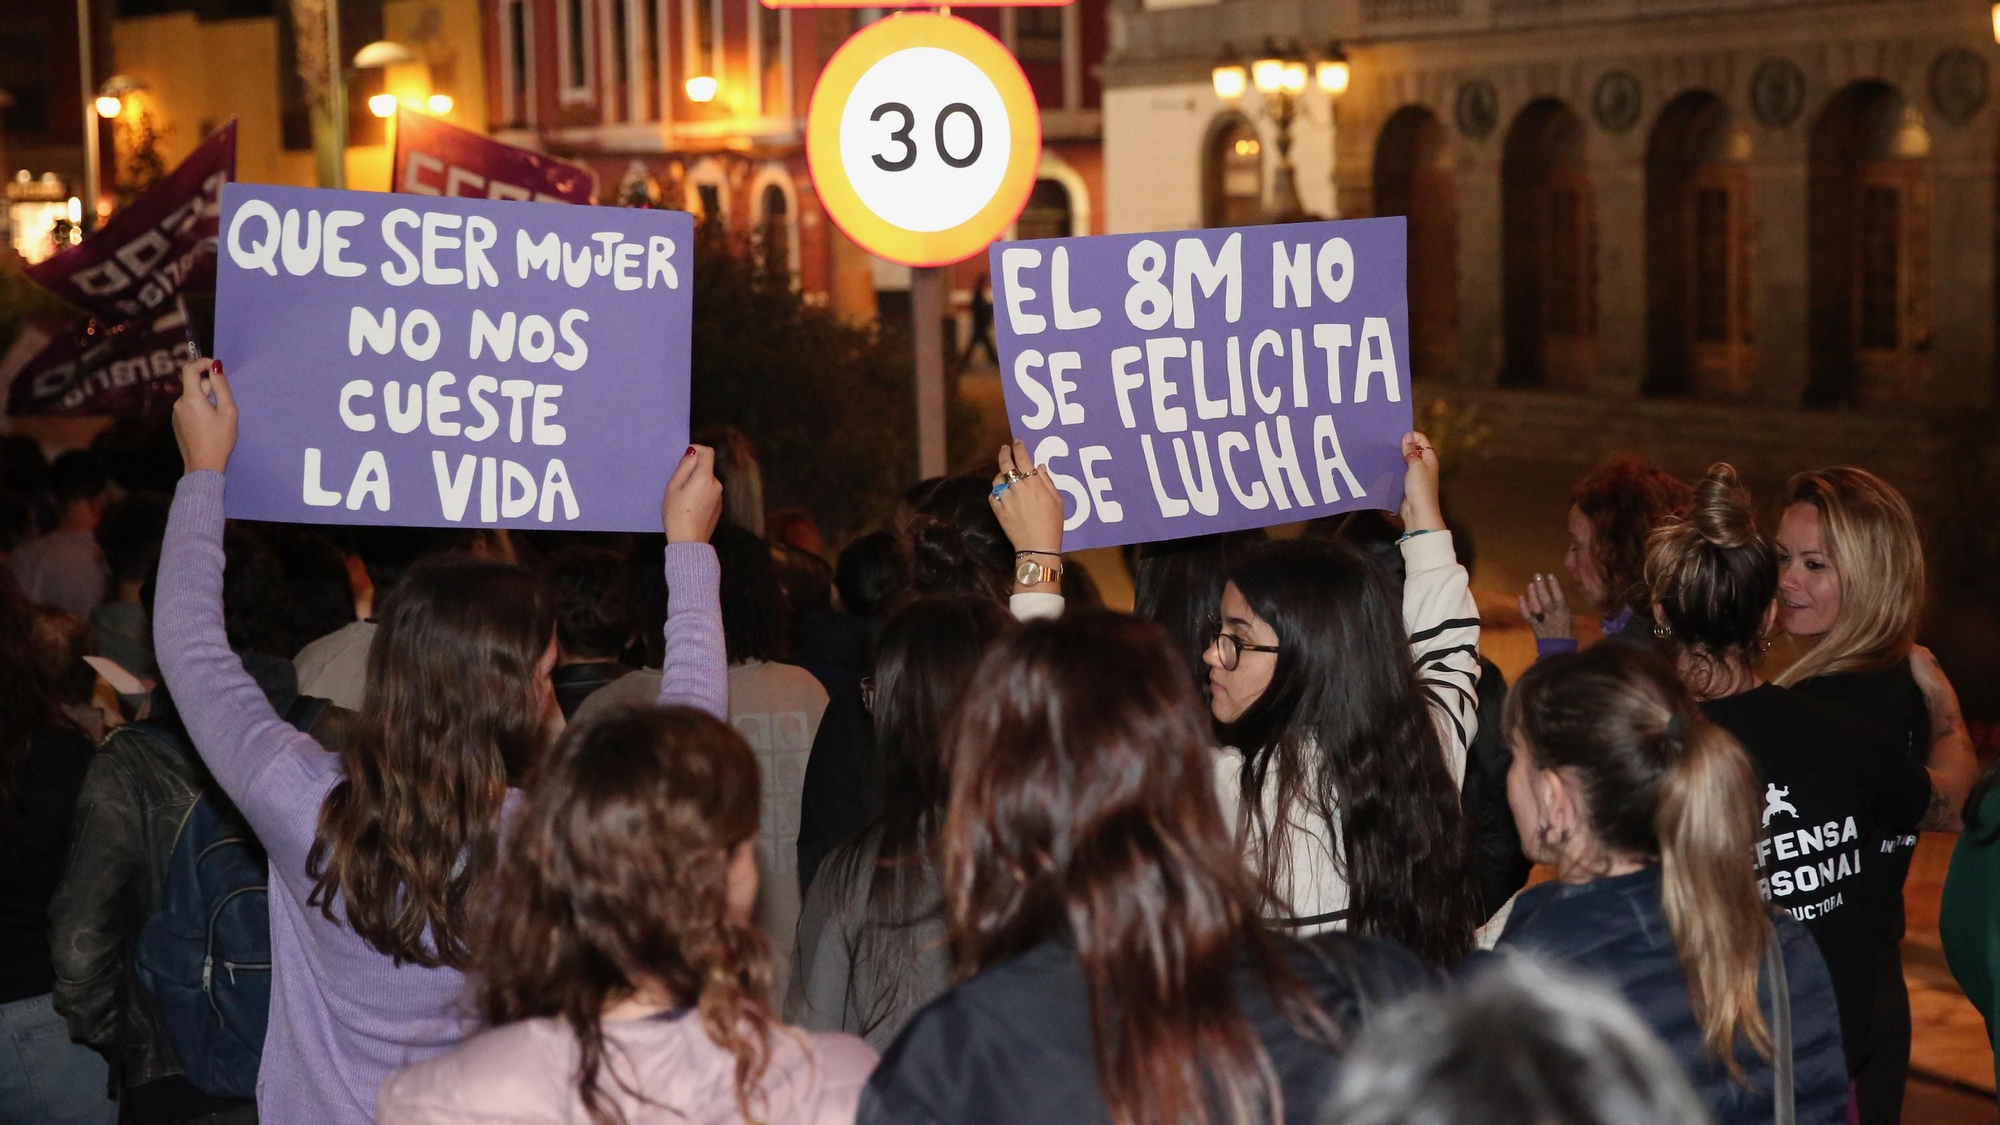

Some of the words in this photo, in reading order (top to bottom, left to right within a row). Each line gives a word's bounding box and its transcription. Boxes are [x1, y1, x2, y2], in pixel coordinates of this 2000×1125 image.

[870, 102, 983, 172] 30
[226, 198, 367, 279] QUE
[381, 208, 499, 290] SER
[516, 229, 679, 292] MUJER
[1001, 246, 1102, 336] EL
[1125, 230, 1243, 331] 8M
[1273, 236, 1355, 309] NO
[348, 306, 442, 362] NO
[469, 309, 589, 371] NOS
[1013, 348, 1086, 431] SE
[1111, 316, 1402, 434] FELICITA
[339, 370, 567, 446] CUESTE
[303, 447, 391, 512] LA
[432, 449, 581, 523] VIDA
[1033, 435, 1124, 532] SE
[1141, 414, 1367, 518] LUCHA
